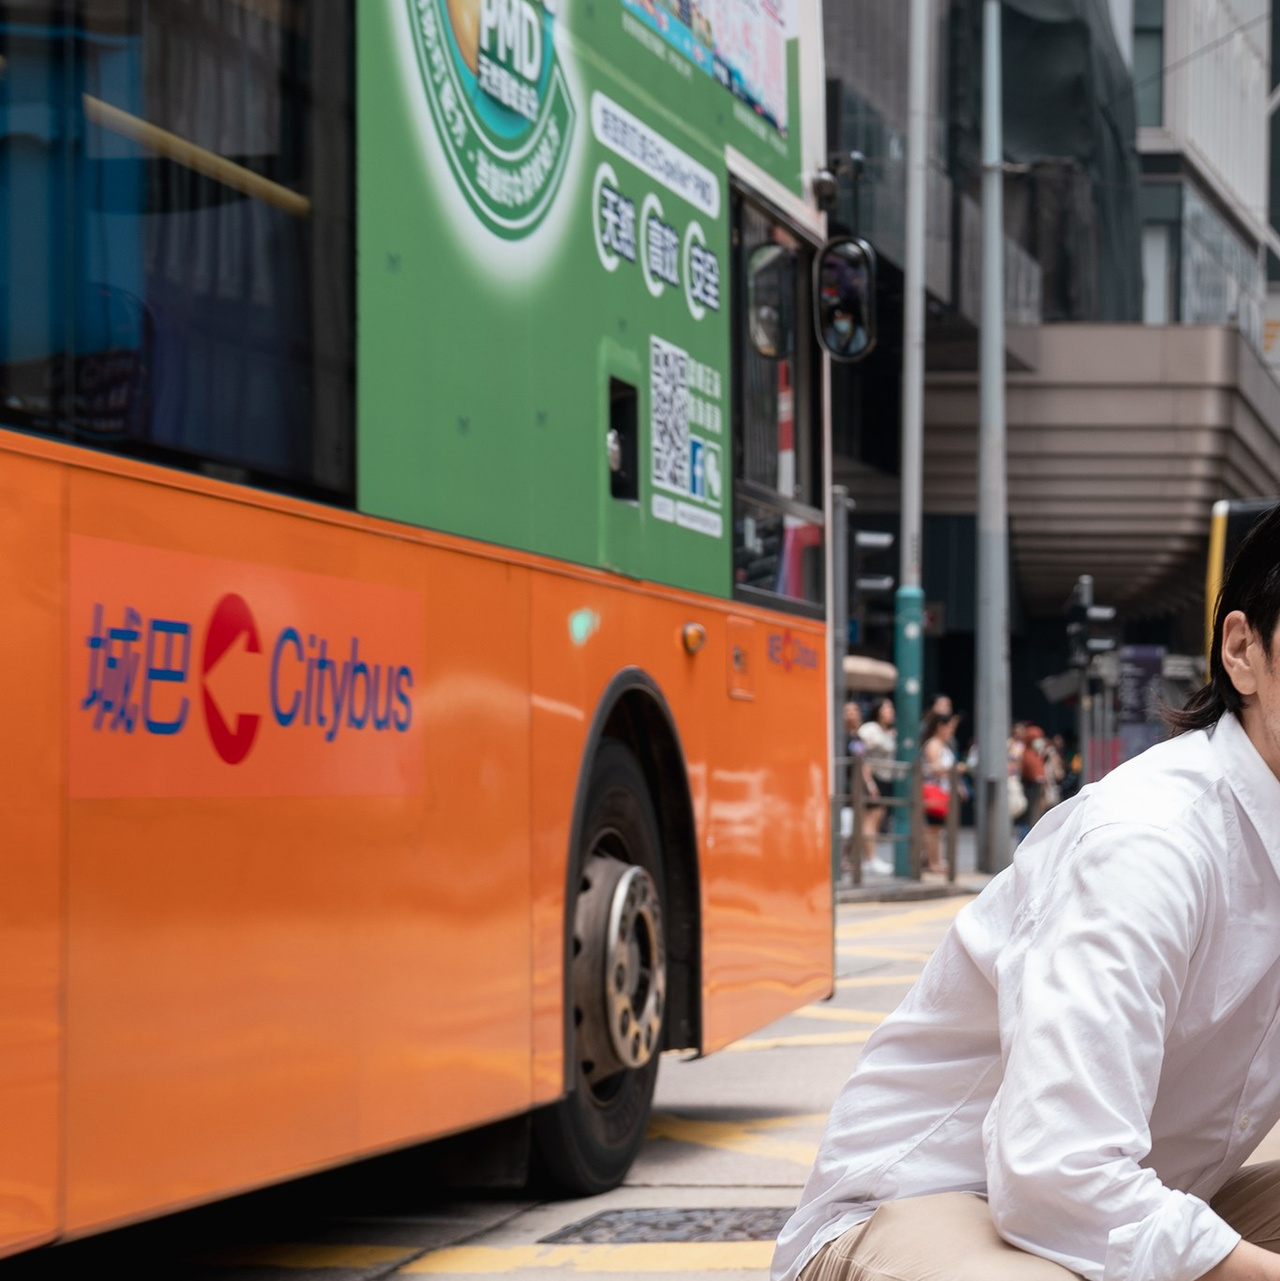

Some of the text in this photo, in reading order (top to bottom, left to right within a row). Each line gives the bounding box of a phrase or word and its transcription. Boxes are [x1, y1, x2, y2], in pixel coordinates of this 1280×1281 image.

[601, 184, 637, 265] 天然
[689, 242, 721, 312] 安全
[80, 602, 193, 737] 城巴
[269, 626, 415, 743] Citybus
